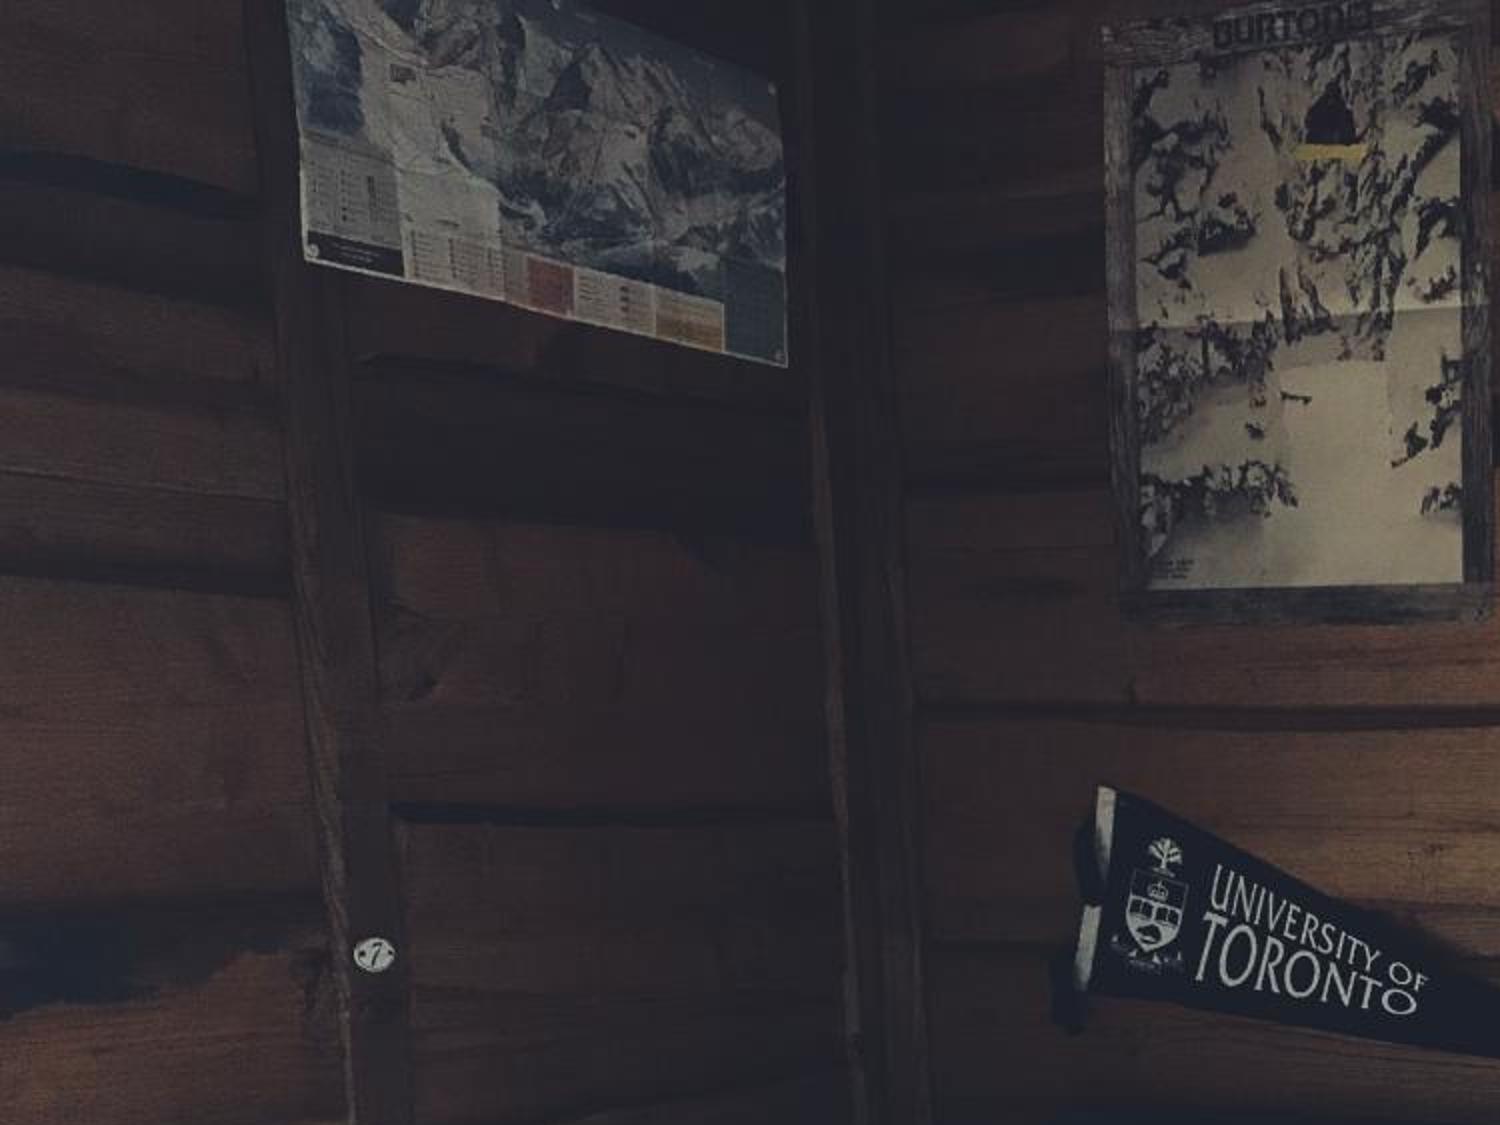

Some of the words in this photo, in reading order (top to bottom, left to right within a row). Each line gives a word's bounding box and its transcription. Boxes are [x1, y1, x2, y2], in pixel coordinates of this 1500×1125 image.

[371, 941, 382, 967] 7
[1196, 911, 1417, 1014] TORONTO
[1211, 863, 1382, 970] UNIVERSITY
[1389, 961, 1429, 990] OF
